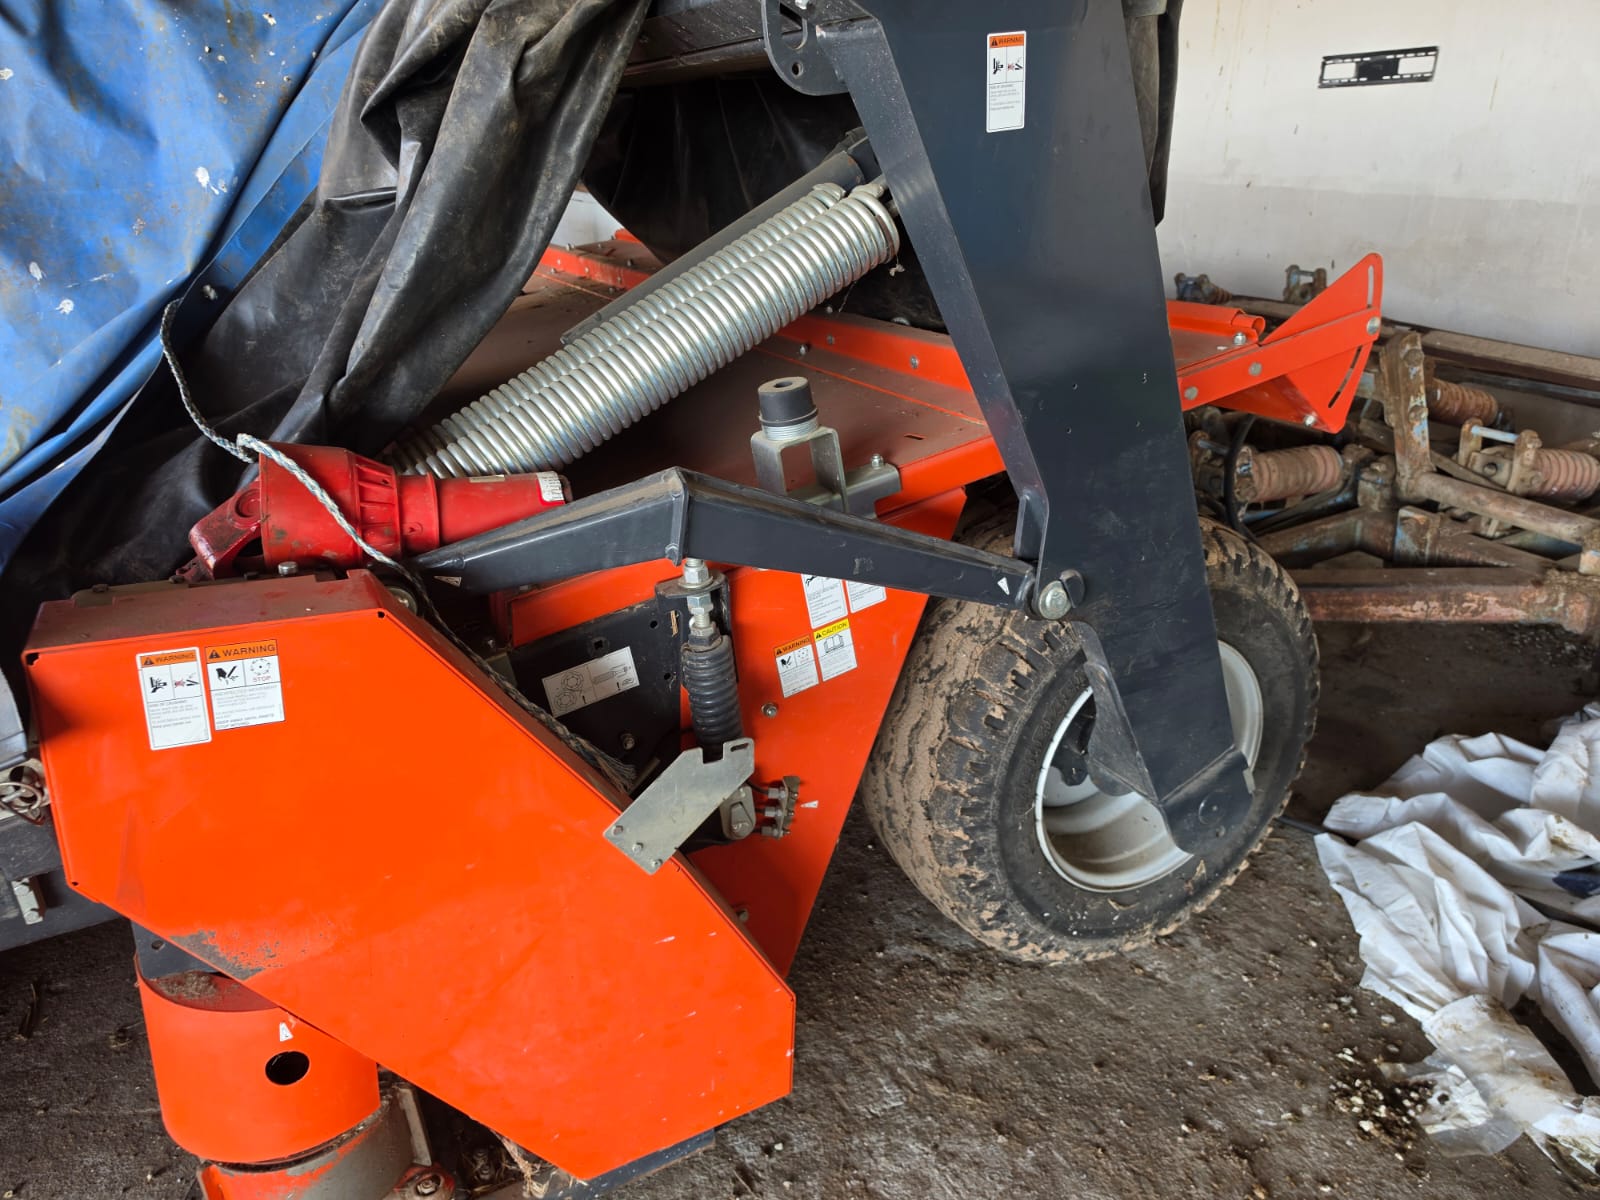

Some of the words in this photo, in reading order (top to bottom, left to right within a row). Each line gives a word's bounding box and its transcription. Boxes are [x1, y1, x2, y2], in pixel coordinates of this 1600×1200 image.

[821, 622, 847, 636] CAUTION
[222, 644, 275, 657] WARNING
[155, 652, 196, 663] WARNING
[253, 675, 271, 683] STOP
